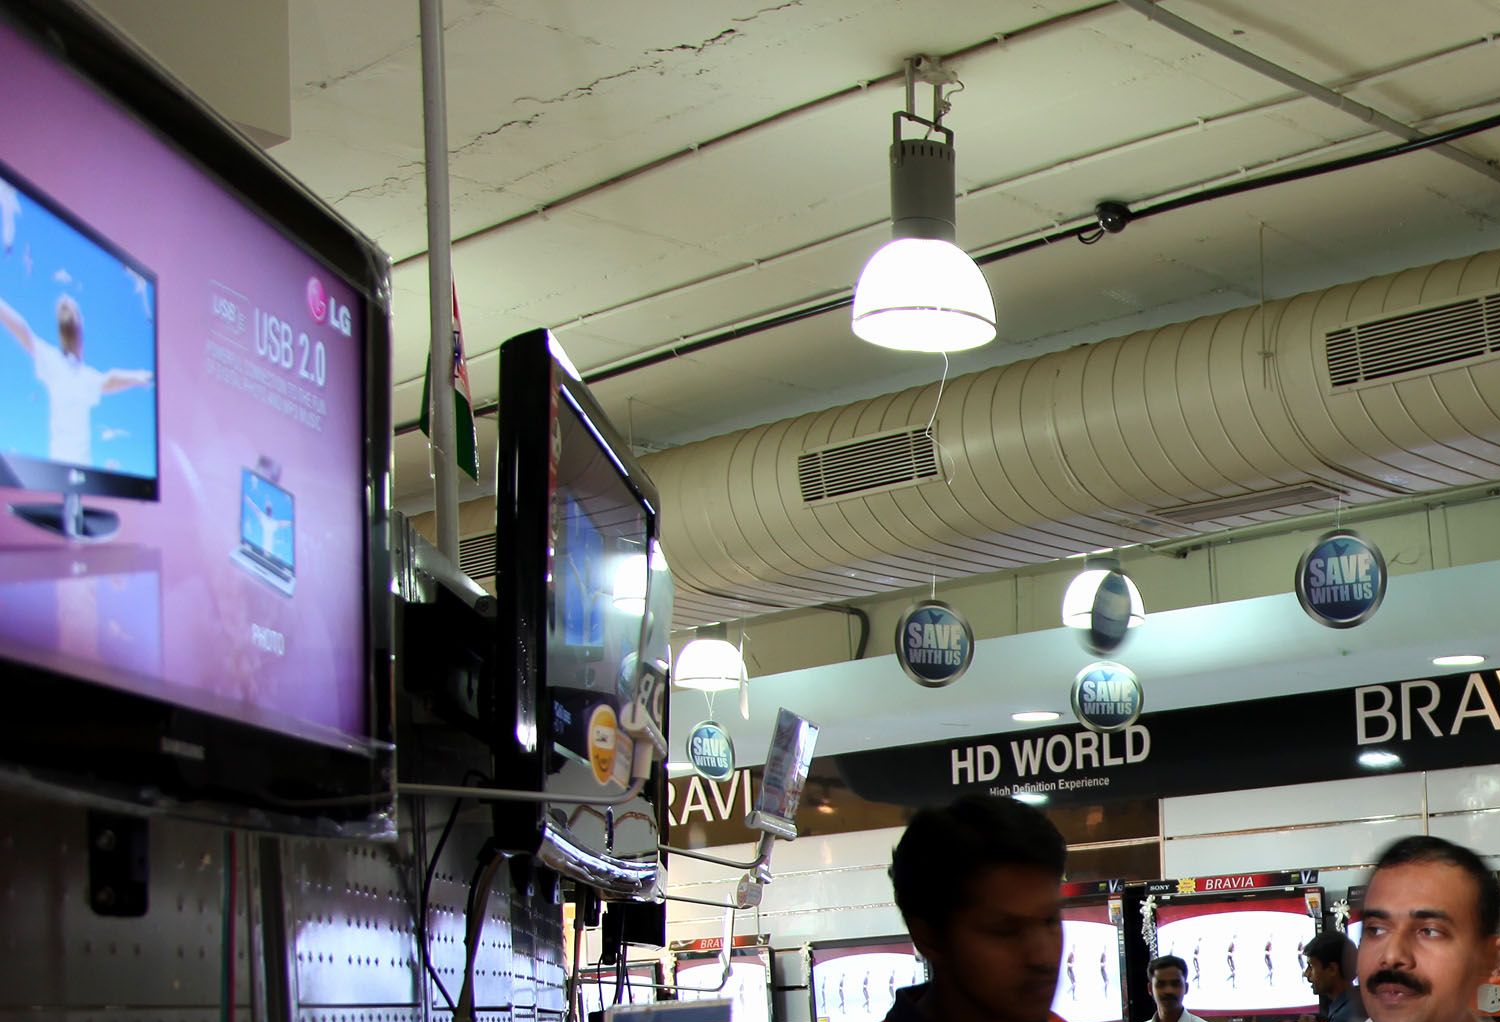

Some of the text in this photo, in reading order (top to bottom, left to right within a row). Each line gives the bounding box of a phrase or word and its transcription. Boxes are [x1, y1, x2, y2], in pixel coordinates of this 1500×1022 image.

[330, 296, 352, 337] LG
[255, 307, 294, 369] USB
[299, 332, 326, 387] 2.0
[1309, 552, 1373, 589] SAVE
[1310, 580, 1373, 604] WITH US
[908, 622, 961, 650] SAVE
[908, 648, 961, 666] WITH US
[1083, 680, 1134, 703] SAVE
[1083, 702, 1133, 715] WITH US
[693, 736, 727, 758] SAVE
[951, 724, 1151, 785] HD WORLD
[694, 755, 729, 769] WITH US
[1012, 781, 1057, 795] Definition
[1058, 776, 1110, 791] Experience
[1205, 876, 1254, 890] BRAVIA
